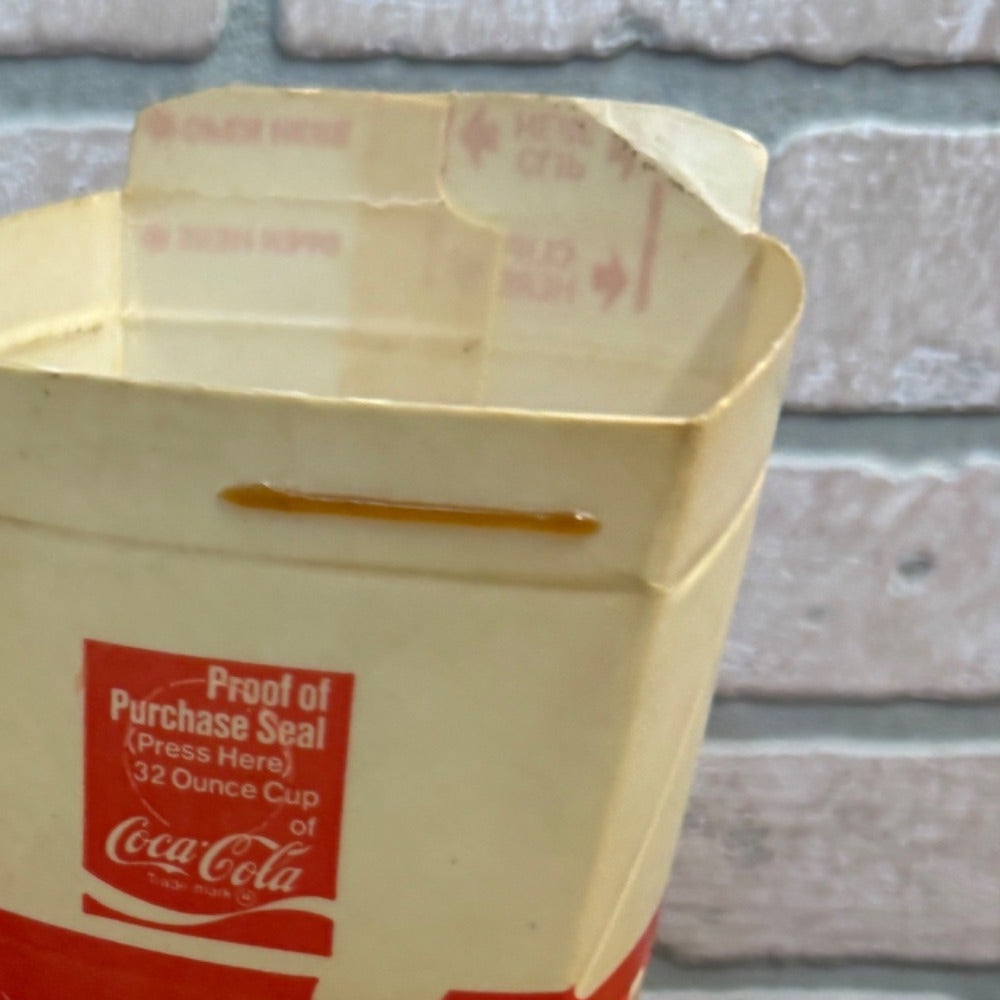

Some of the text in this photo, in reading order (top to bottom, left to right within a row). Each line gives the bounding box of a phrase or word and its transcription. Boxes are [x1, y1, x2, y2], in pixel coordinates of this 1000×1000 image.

[207, 664, 332, 711] Proof of
[110, 688, 327, 749] Purchase Seal
[125, 727, 293, 778] (Press Here)
[133, 760, 320, 810] 32 Ounce Cup
[289, 817, 317, 837] of
[105, 815, 313, 893] Coca-Cola
